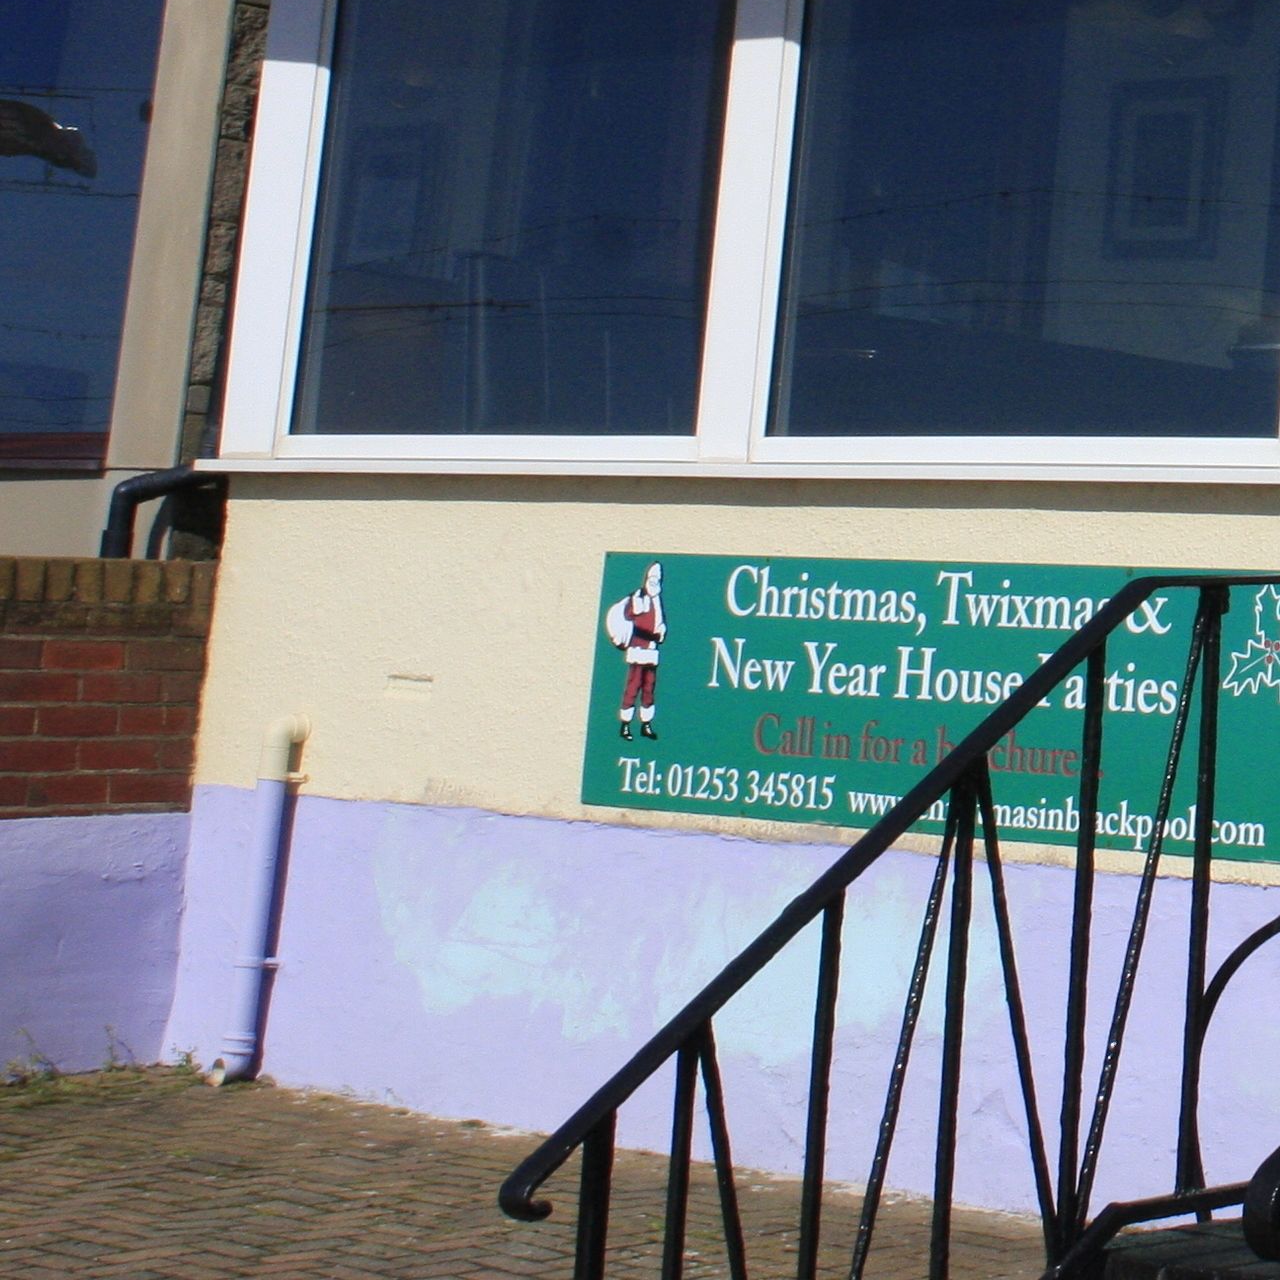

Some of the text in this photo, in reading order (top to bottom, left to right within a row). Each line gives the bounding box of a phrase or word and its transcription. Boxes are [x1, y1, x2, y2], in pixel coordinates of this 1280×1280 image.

[726, 564, 926, 636] Christmas,
[707, 637, 1178, 715] New Year House aties
[753, 712, 816, 758] Call
[820, 721, 850, 759] in
[859, 719, 905, 763] for
[911, 736, 927, 766] a
[618, 756, 661, 796] Tel:
[666, 762, 740, 803] 01253
[744, 769, 836, 811] 345815
